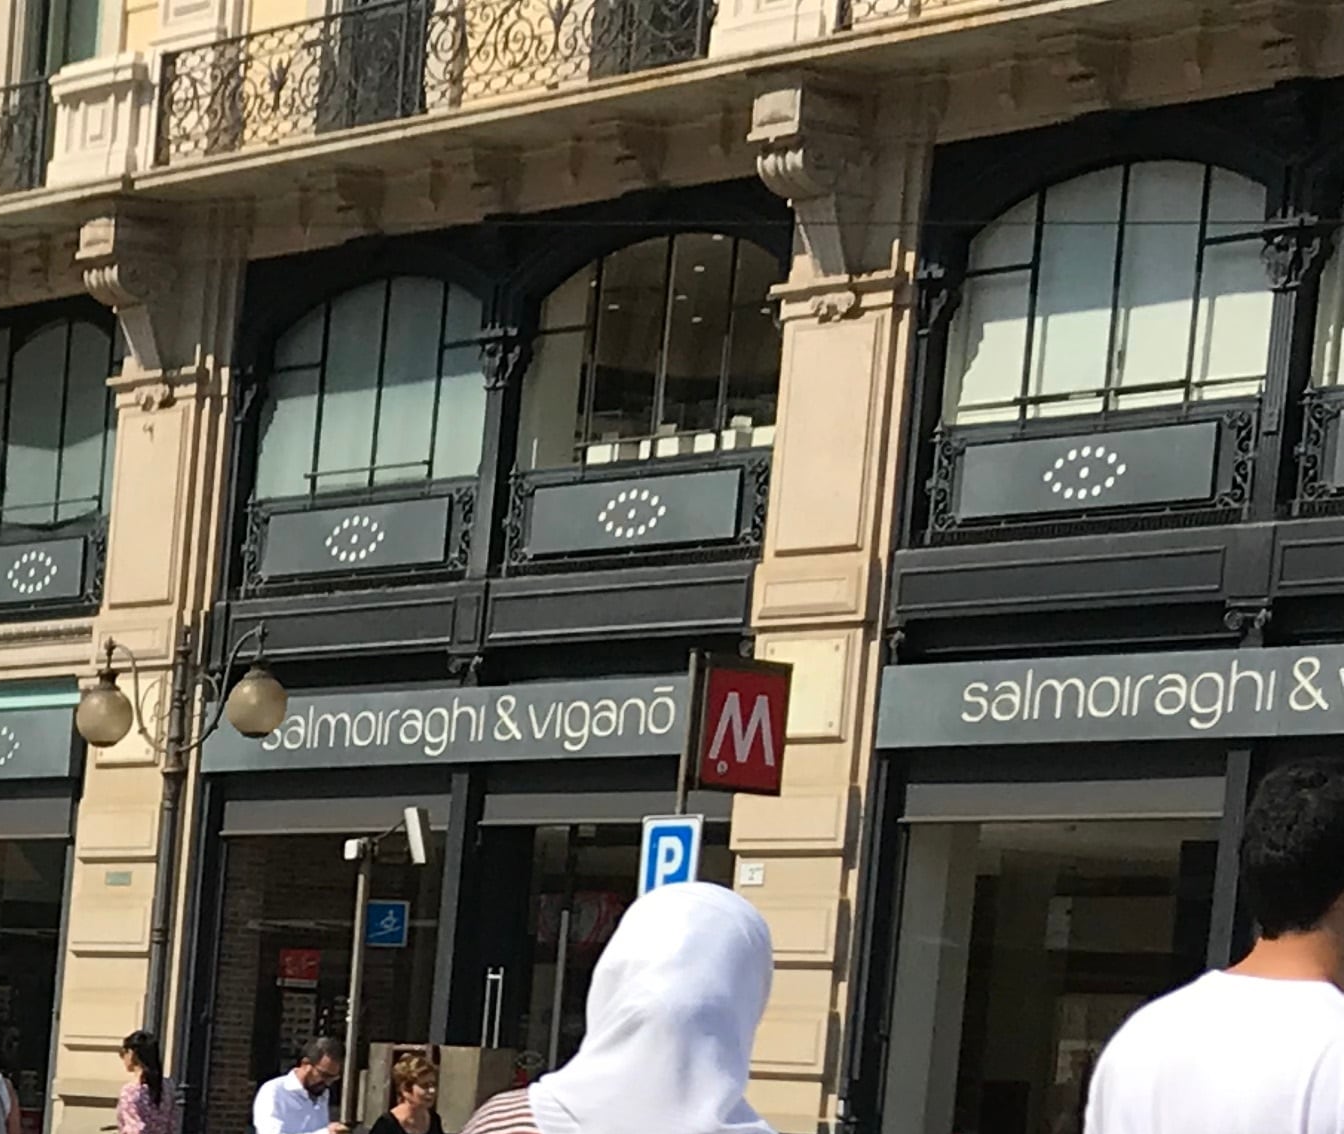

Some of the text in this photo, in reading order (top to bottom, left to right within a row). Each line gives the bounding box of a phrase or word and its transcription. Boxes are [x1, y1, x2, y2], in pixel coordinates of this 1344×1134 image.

[493, 694, 523, 741] &
[960, 656, 1330, 730] salmoiraghi &
[708, 691, 775, 767] M
[653, 836, 684, 889] P
